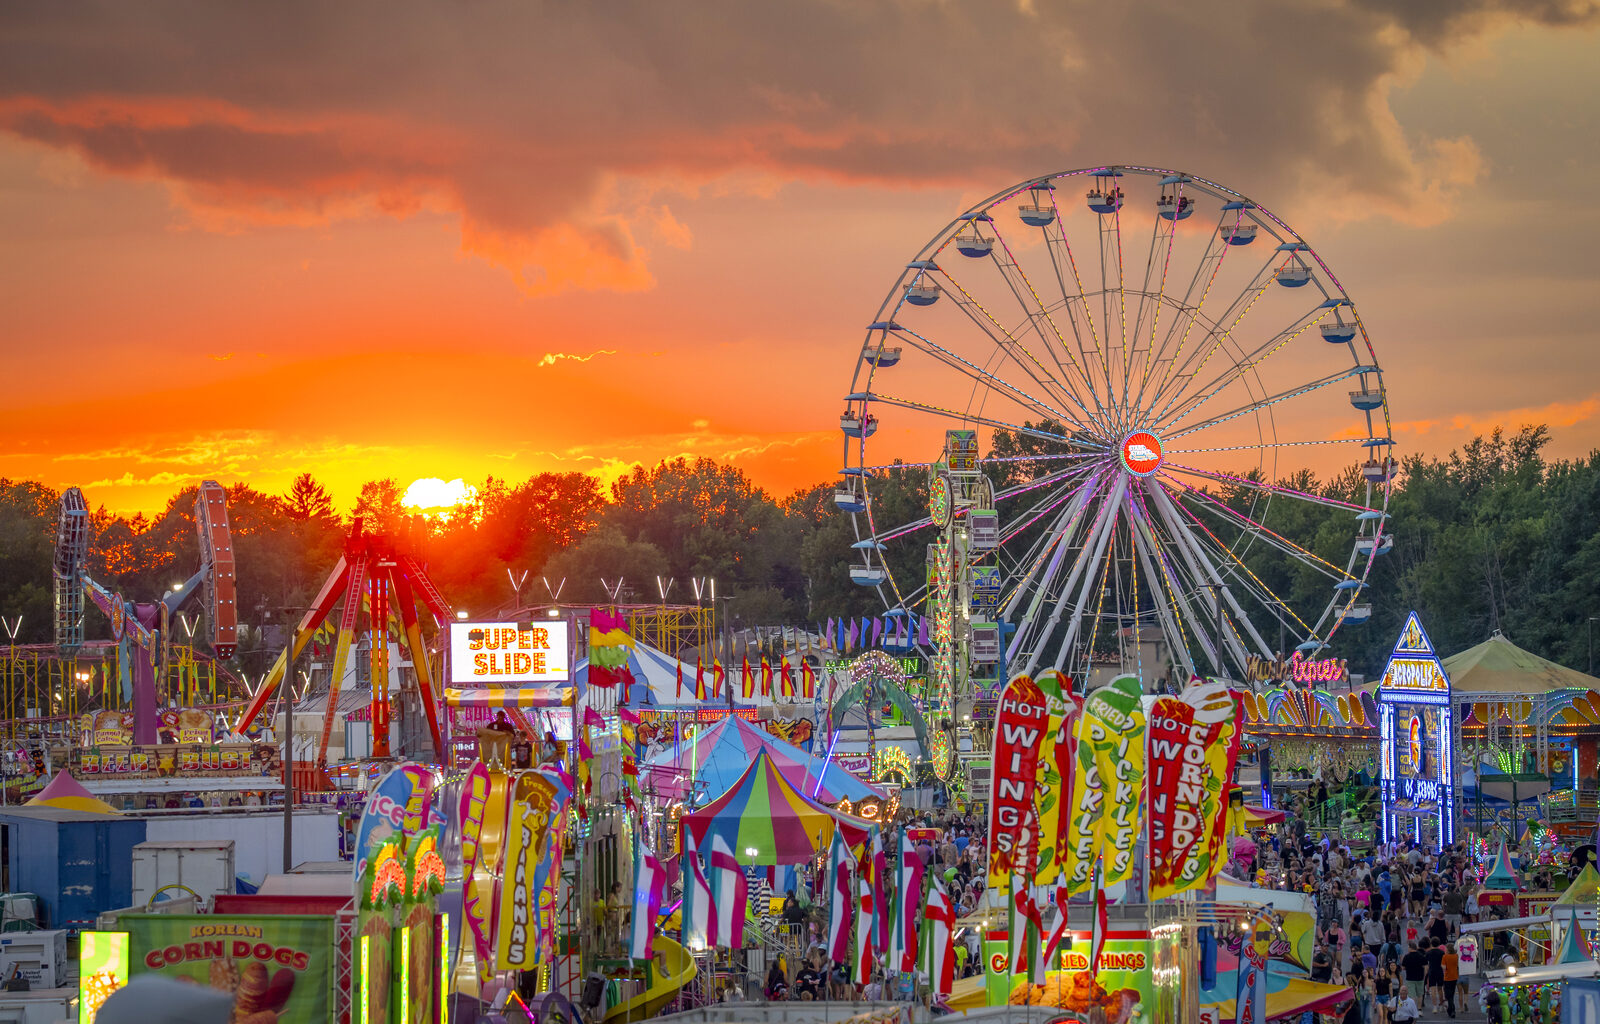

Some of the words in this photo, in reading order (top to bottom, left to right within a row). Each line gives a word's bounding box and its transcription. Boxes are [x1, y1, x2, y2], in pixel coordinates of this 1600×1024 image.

[468, 627, 551, 650] SUPER
[473, 652, 547, 675] SLIDE
[1393, 663, 1433, 687] ACROPOLIS
[1002, 699, 1047, 720] HOT
[1091, 698, 1126, 727] FRIED
[1151, 714, 1191, 736] HOT
[1175, 723, 1209, 808] CORN
[996, 722, 1040, 854] WINGS
[1072, 723, 1106, 884] PCKLES
[507, 824, 533, 965] BANANAS
[191, 925, 263, 938] KOREAN
[145, 940, 225, 969] CORN
[232, 940, 310, 971] DOGS
[1100, 953, 1146, 970] HINGS
